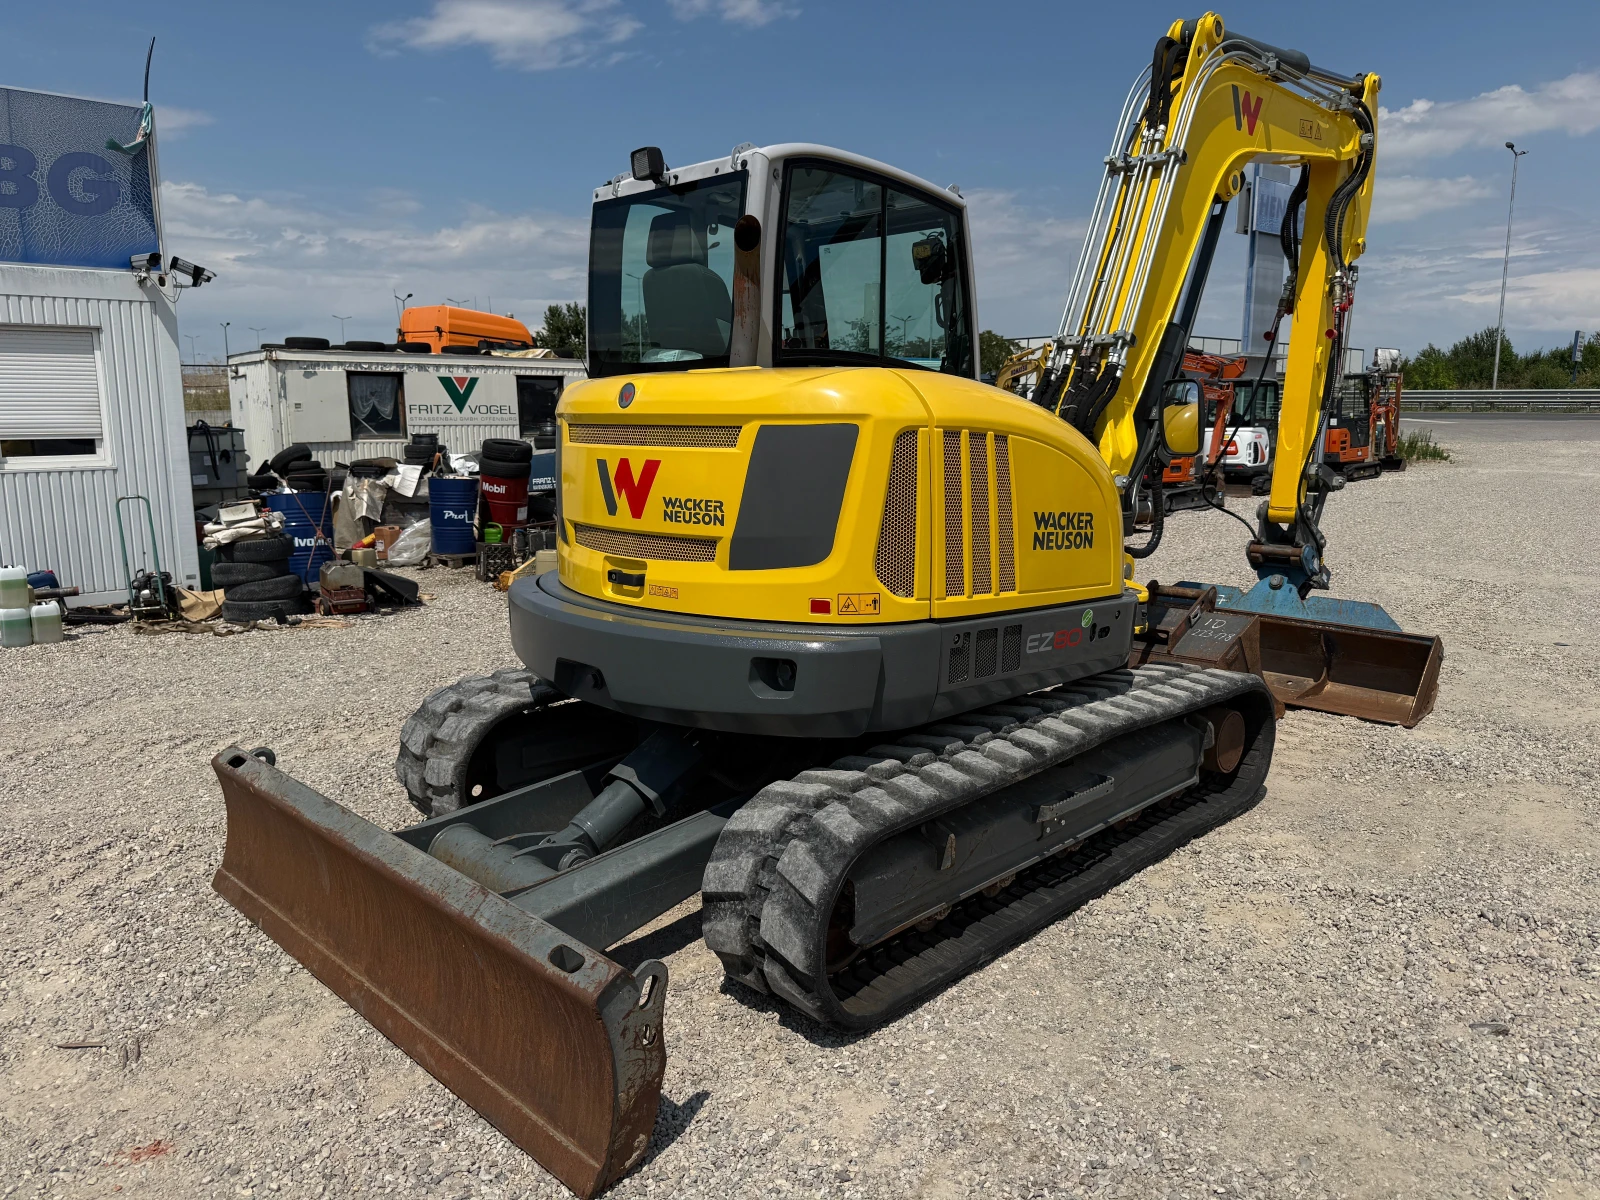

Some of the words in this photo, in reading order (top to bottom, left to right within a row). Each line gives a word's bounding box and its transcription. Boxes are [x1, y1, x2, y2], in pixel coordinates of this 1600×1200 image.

[409, 404, 453, 414] FRITZ
[468, 404, 517, 414] VOGEL
[482, 481, 506, 494] Mobil
[662, 496, 725, 514] WACKER
[663, 510, 725, 527] NEUSON
[1033, 511, 1094, 531] WACKER
[1032, 531, 1094, 551] NEUSON
[1026, 628, 1083, 654] EZ80
